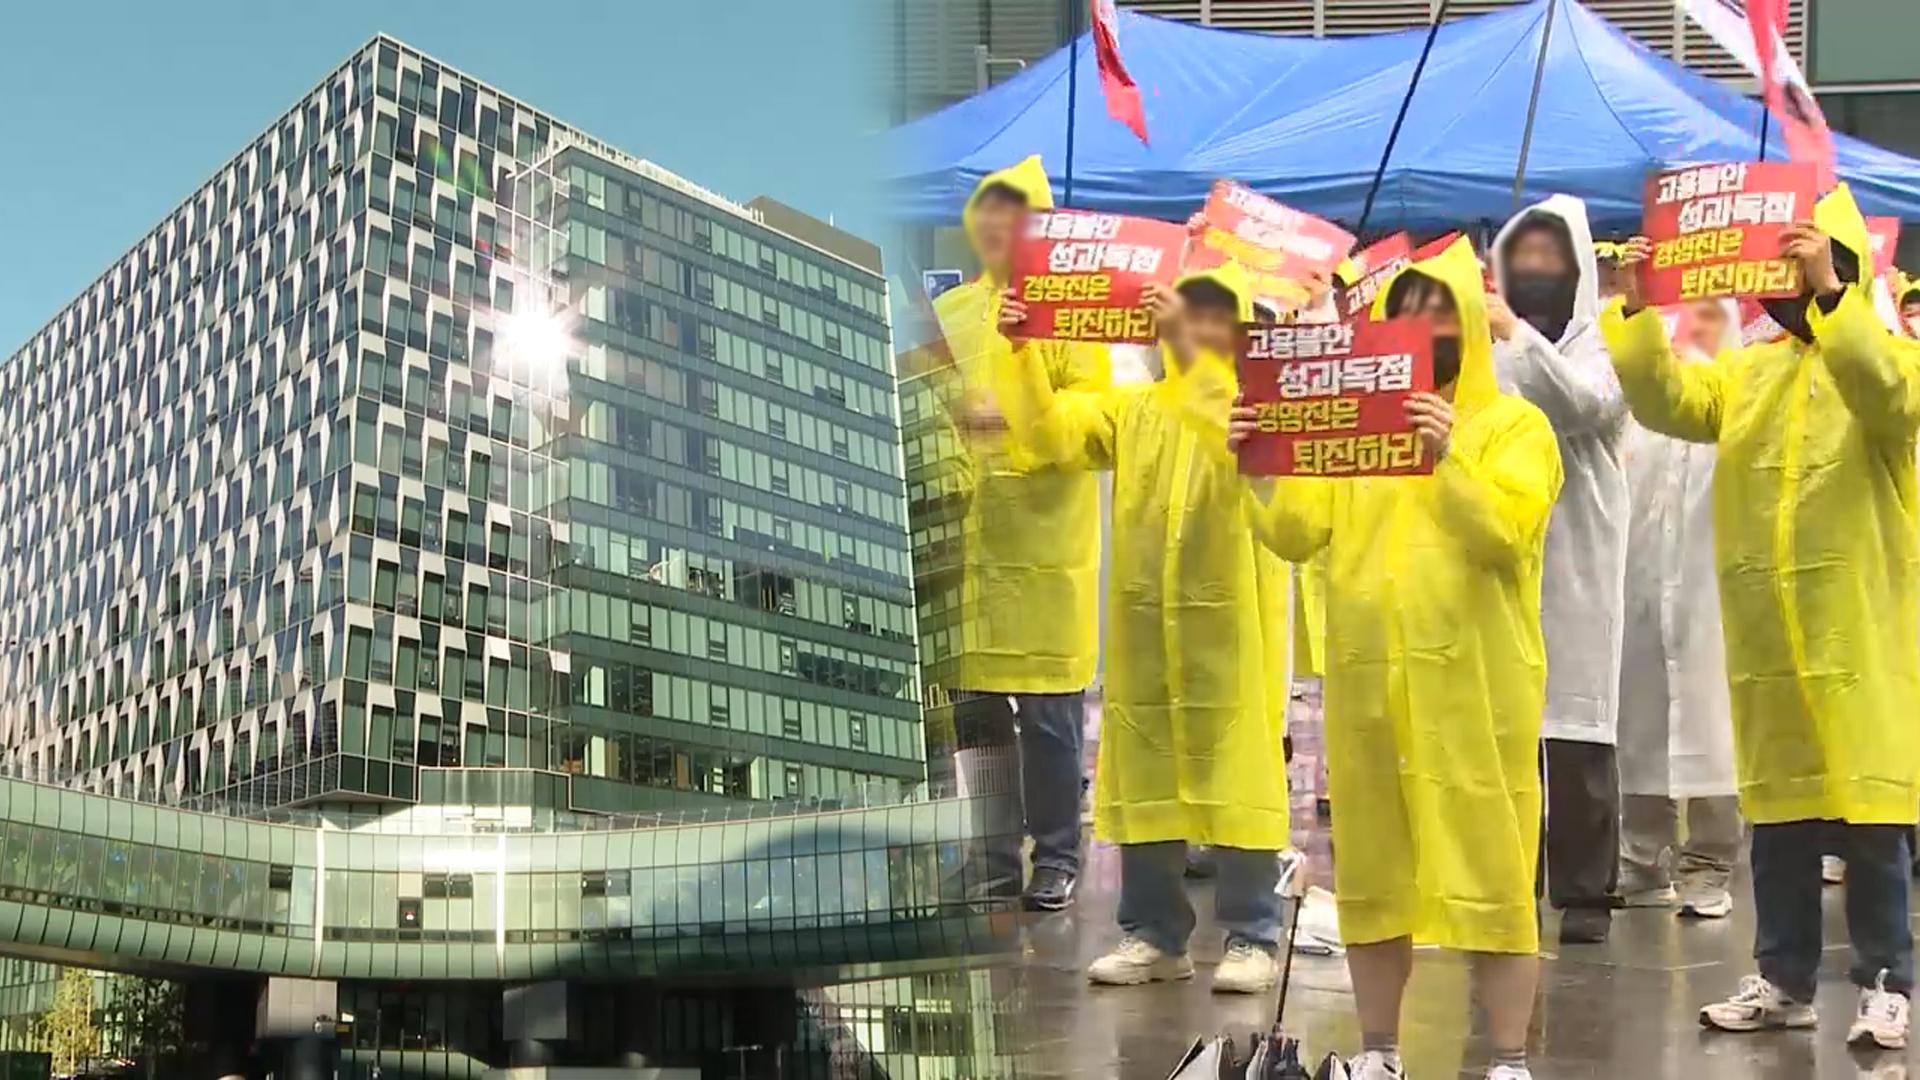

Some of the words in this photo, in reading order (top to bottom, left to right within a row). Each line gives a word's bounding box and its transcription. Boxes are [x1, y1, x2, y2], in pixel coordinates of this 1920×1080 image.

[1657, 163, 1746, 204] 고용불안
[1678, 192, 1794, 231] 성과독점
[1049, 243, 1162, 272] 성과독점
[1654, 230, 1743, 268] 경영진은
[1023, 275, 1111, 302] 경영진은
[1246, 323, 1355, 360] 고용불안
[1277, 354, 1412, 399] 성과독점
[1253, 398, 1360, 433] 경영진은
